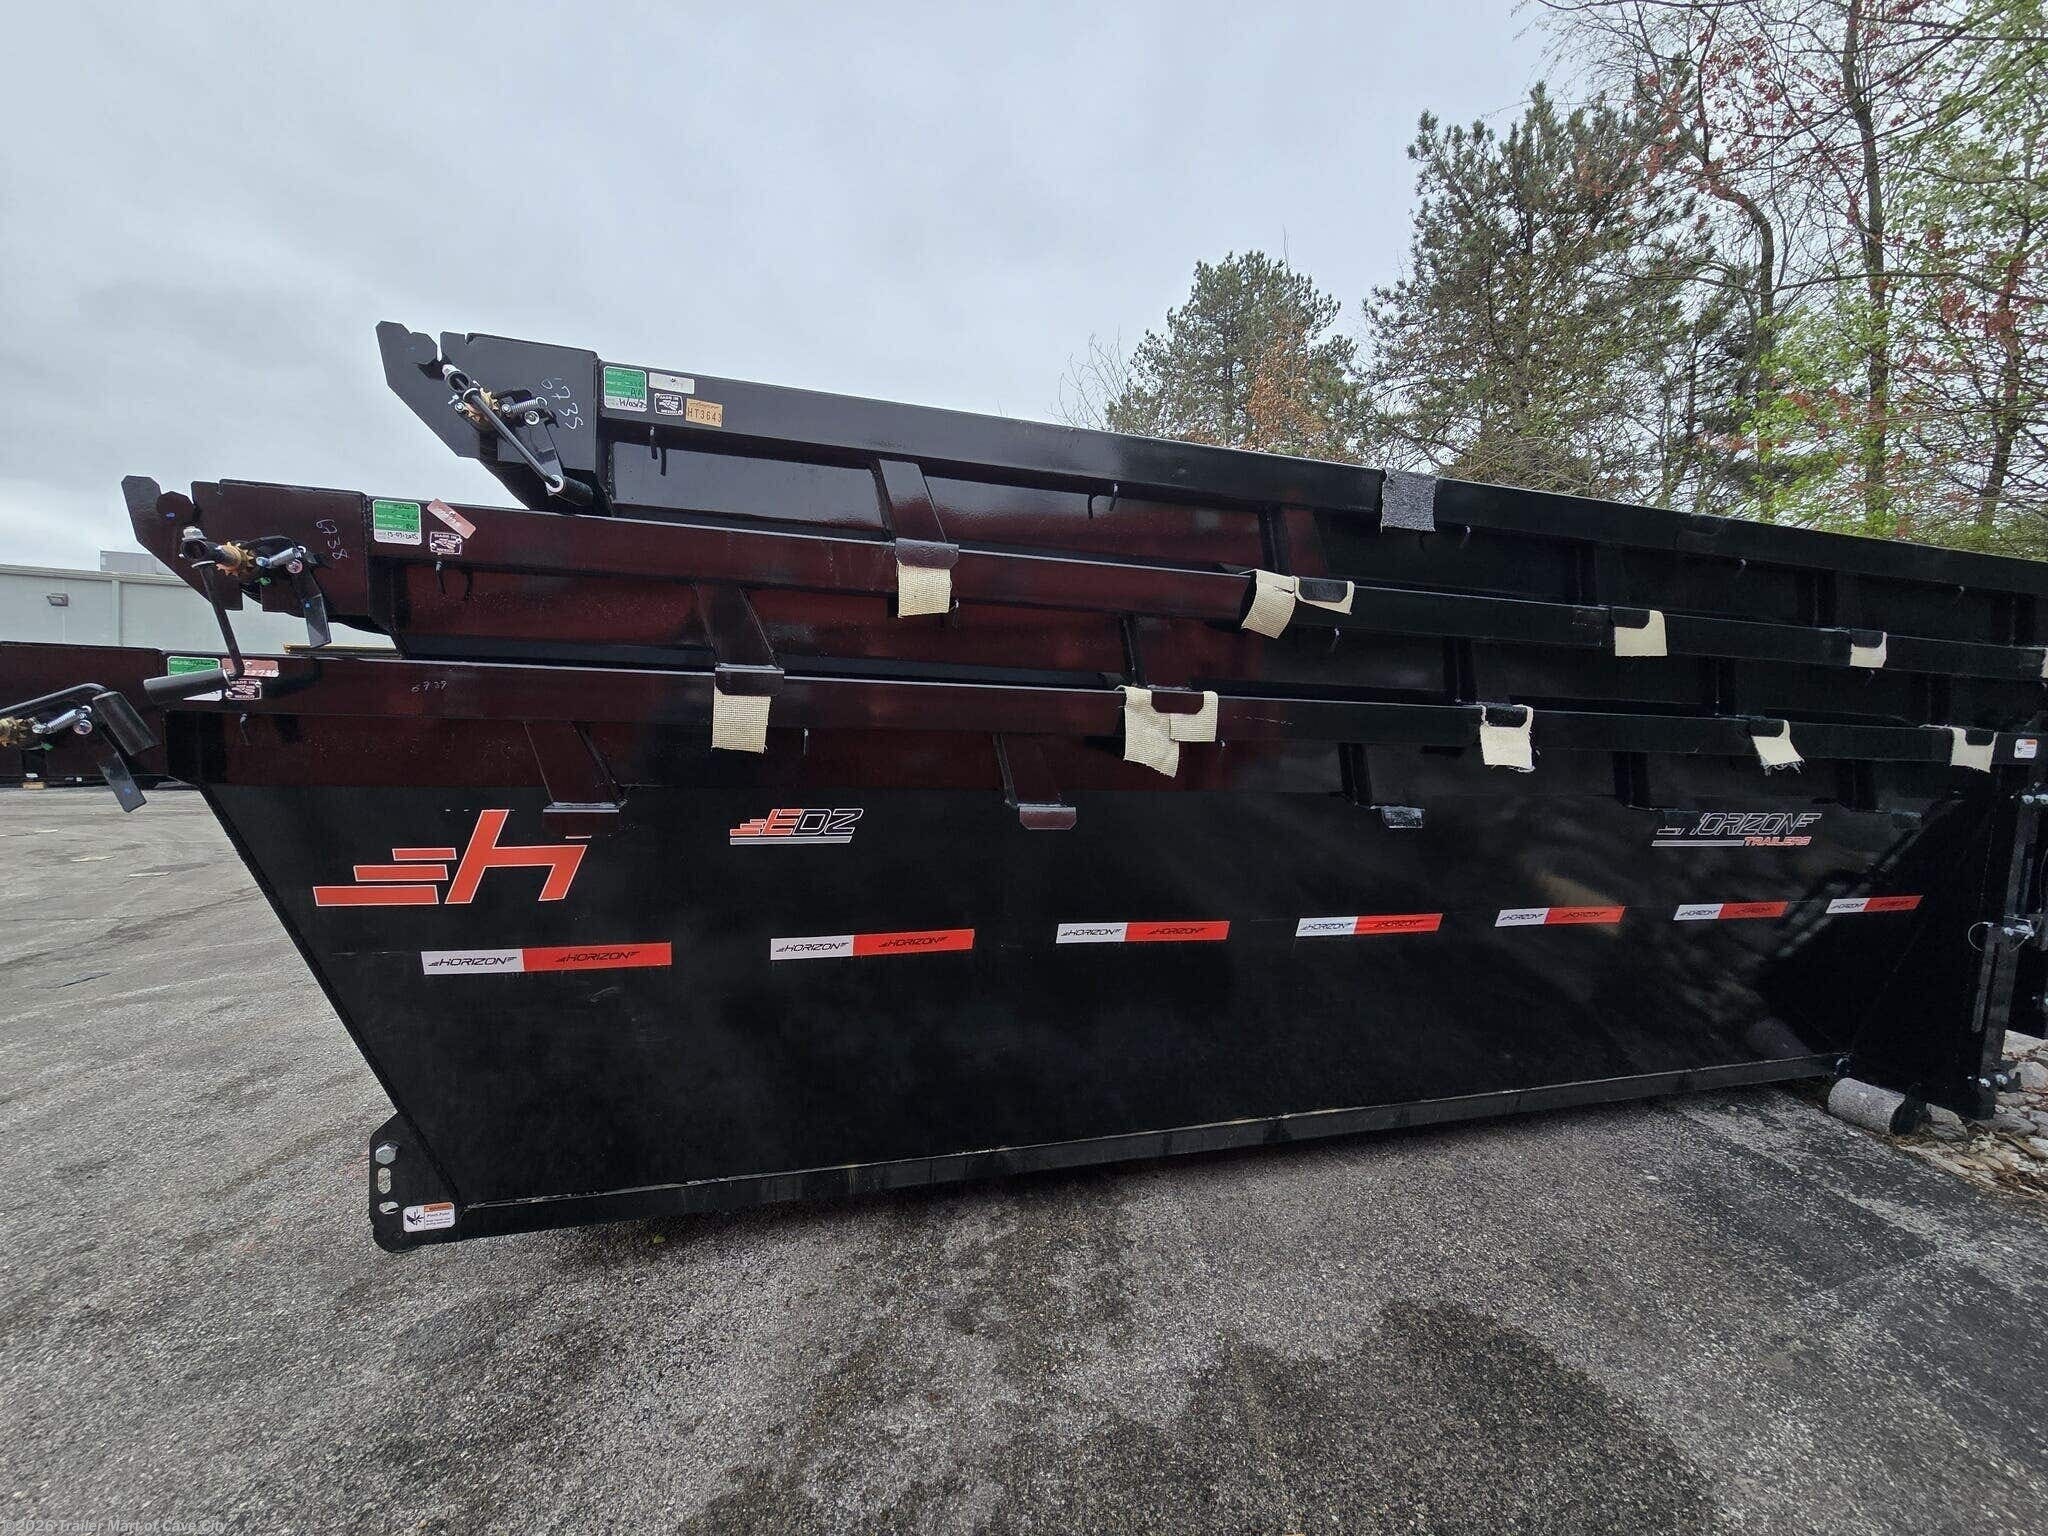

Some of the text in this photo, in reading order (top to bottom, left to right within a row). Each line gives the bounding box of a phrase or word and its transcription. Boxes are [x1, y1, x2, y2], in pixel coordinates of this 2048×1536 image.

[1744, 836, 1812, 847] TRAILERS
[1067, 928, 1116, 936] HORIZON
[783, 936, 940, 953] HORIZON HORIZON
[436, 951, 631, 967] HORIZON HORIZON
